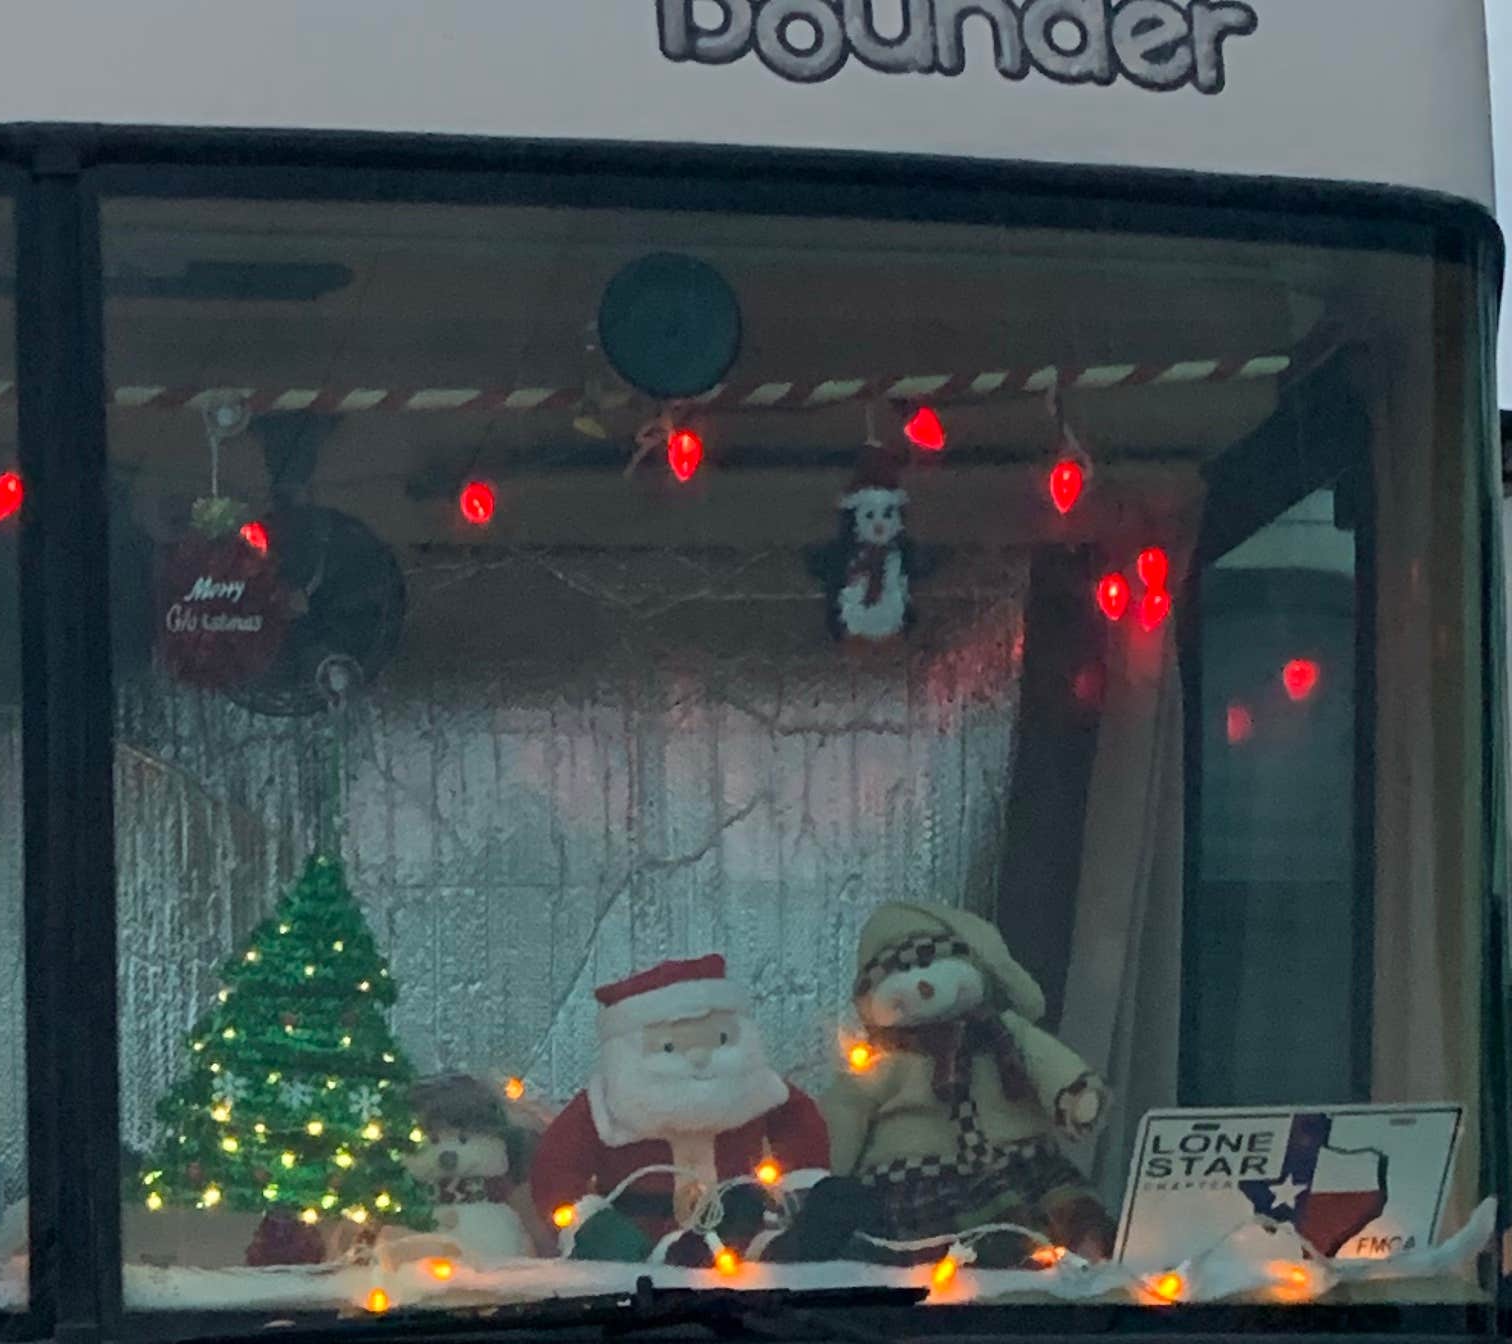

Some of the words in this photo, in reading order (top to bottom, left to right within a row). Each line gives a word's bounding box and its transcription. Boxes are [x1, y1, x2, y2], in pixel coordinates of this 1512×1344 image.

[184, 575, 246, 603] Merry
[1151, 1132, 1275, 1155] LONE
[1145, 1155, 1269, 1178] STAR
